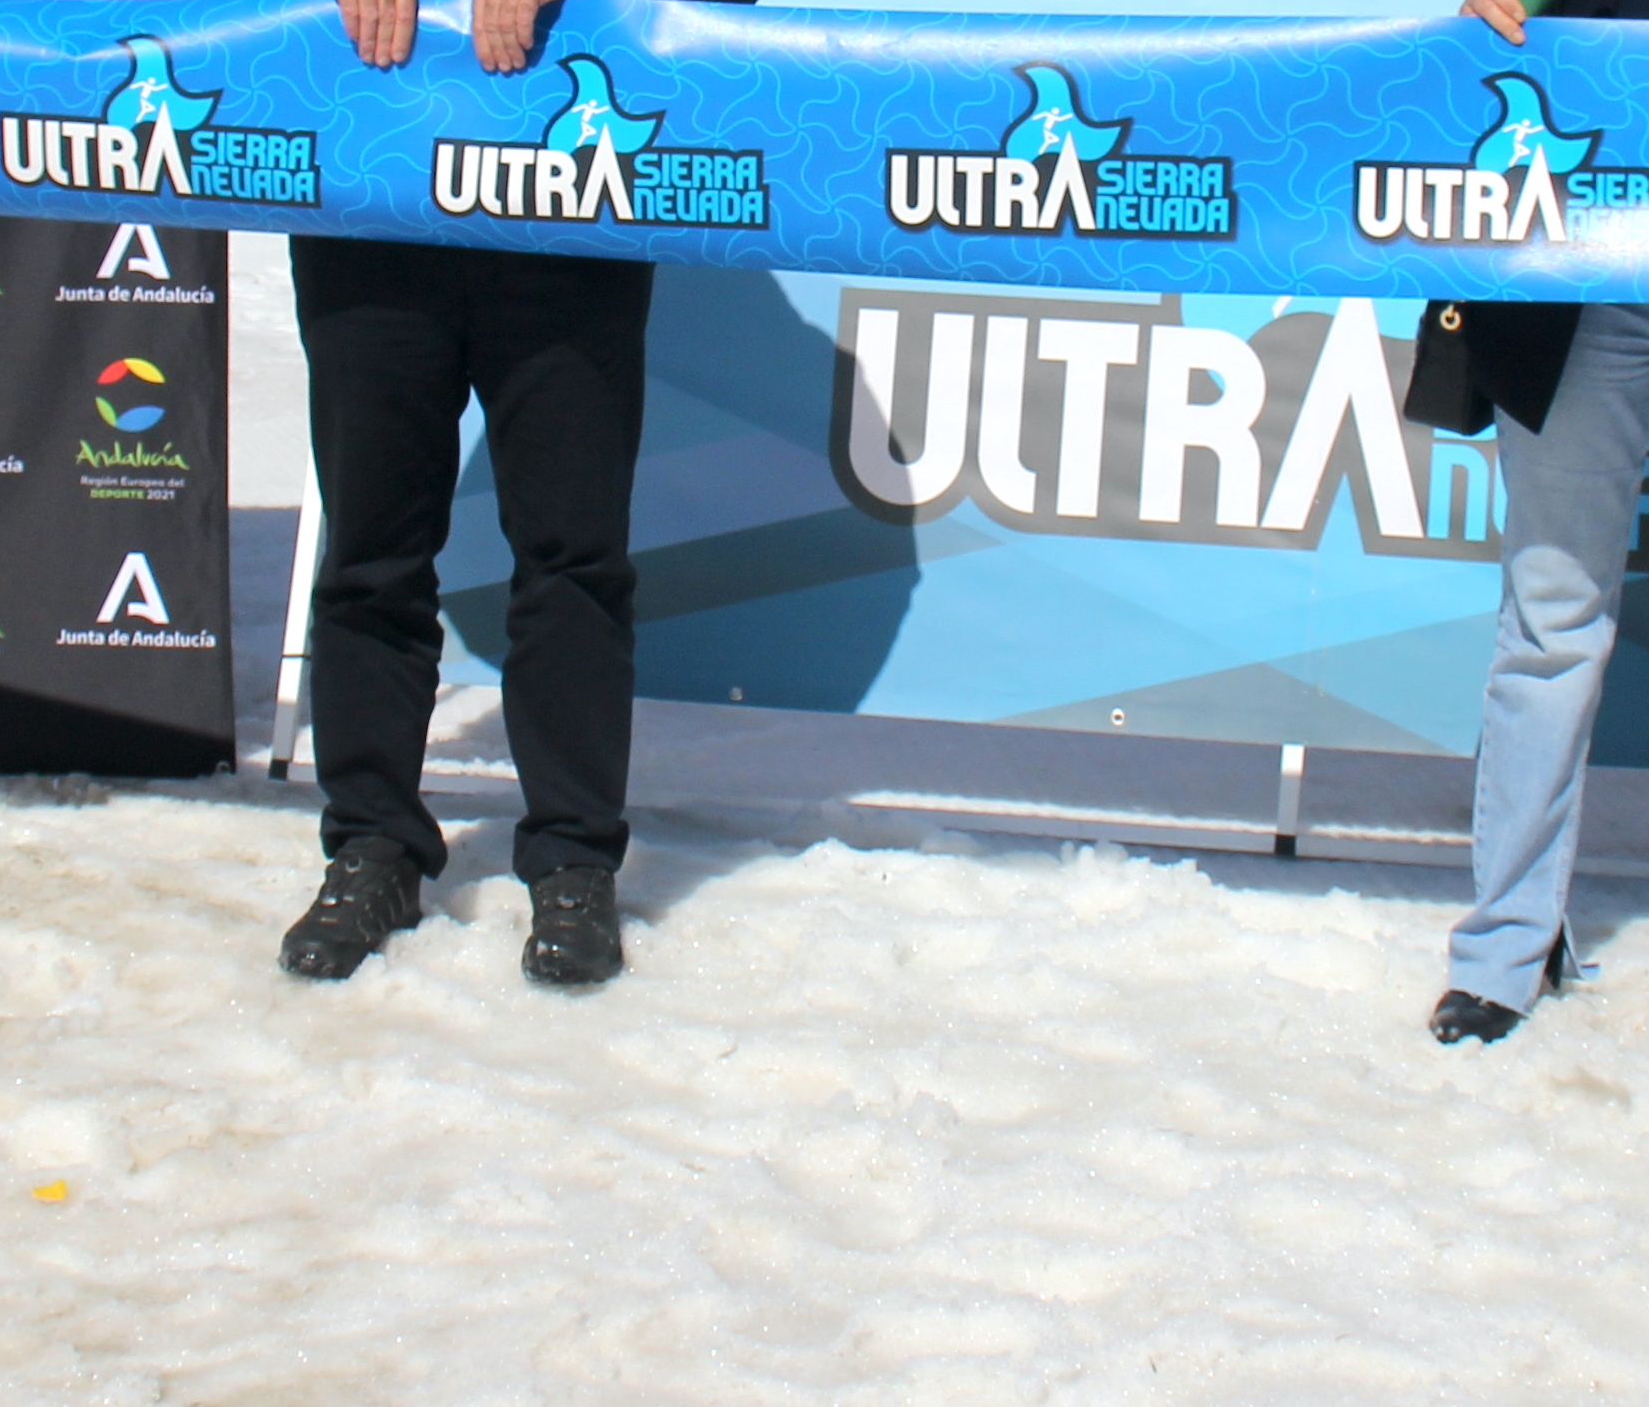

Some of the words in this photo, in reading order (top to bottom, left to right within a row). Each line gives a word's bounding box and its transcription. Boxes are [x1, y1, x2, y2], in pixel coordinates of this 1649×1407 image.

[2, 101, 192, 194] ULTRA
[190, 130, 310, 170] SIERRA
[191, 165, 315, 202] NEVADA
[435, 123, 633, 220] ULTRA
[634, 153, 758, 189] SIERRA
[890, 130, 1096, 230] ULTRA
[1097, 161, 1223, 197] SIERRA
[634, 188, 763, 224] NEVADA
[1358, 143, 1566, 242] ULTRA
[1097, 196, 1229, 232] NEVADA
[55, 285, 103, 303] Junta
[108, 286, 130, 303] de
[132, 286, 214, 304] Andalucía
[850, 297, 1425, 538] ULTRA
[76, 440, 190, 470] Andalucía
[80, 475, 118, 488] Región
[121, 475, 165, 489] Europea
[168, 477, 185, 488] del
[90, 488, 144, 499] DEPORTE
[147, 489, 175, 500] 2021
[56, 629, 105, 645] Junta
[108, 629, 129, 646] de
[132, 629, 216, 648] Andalucía
